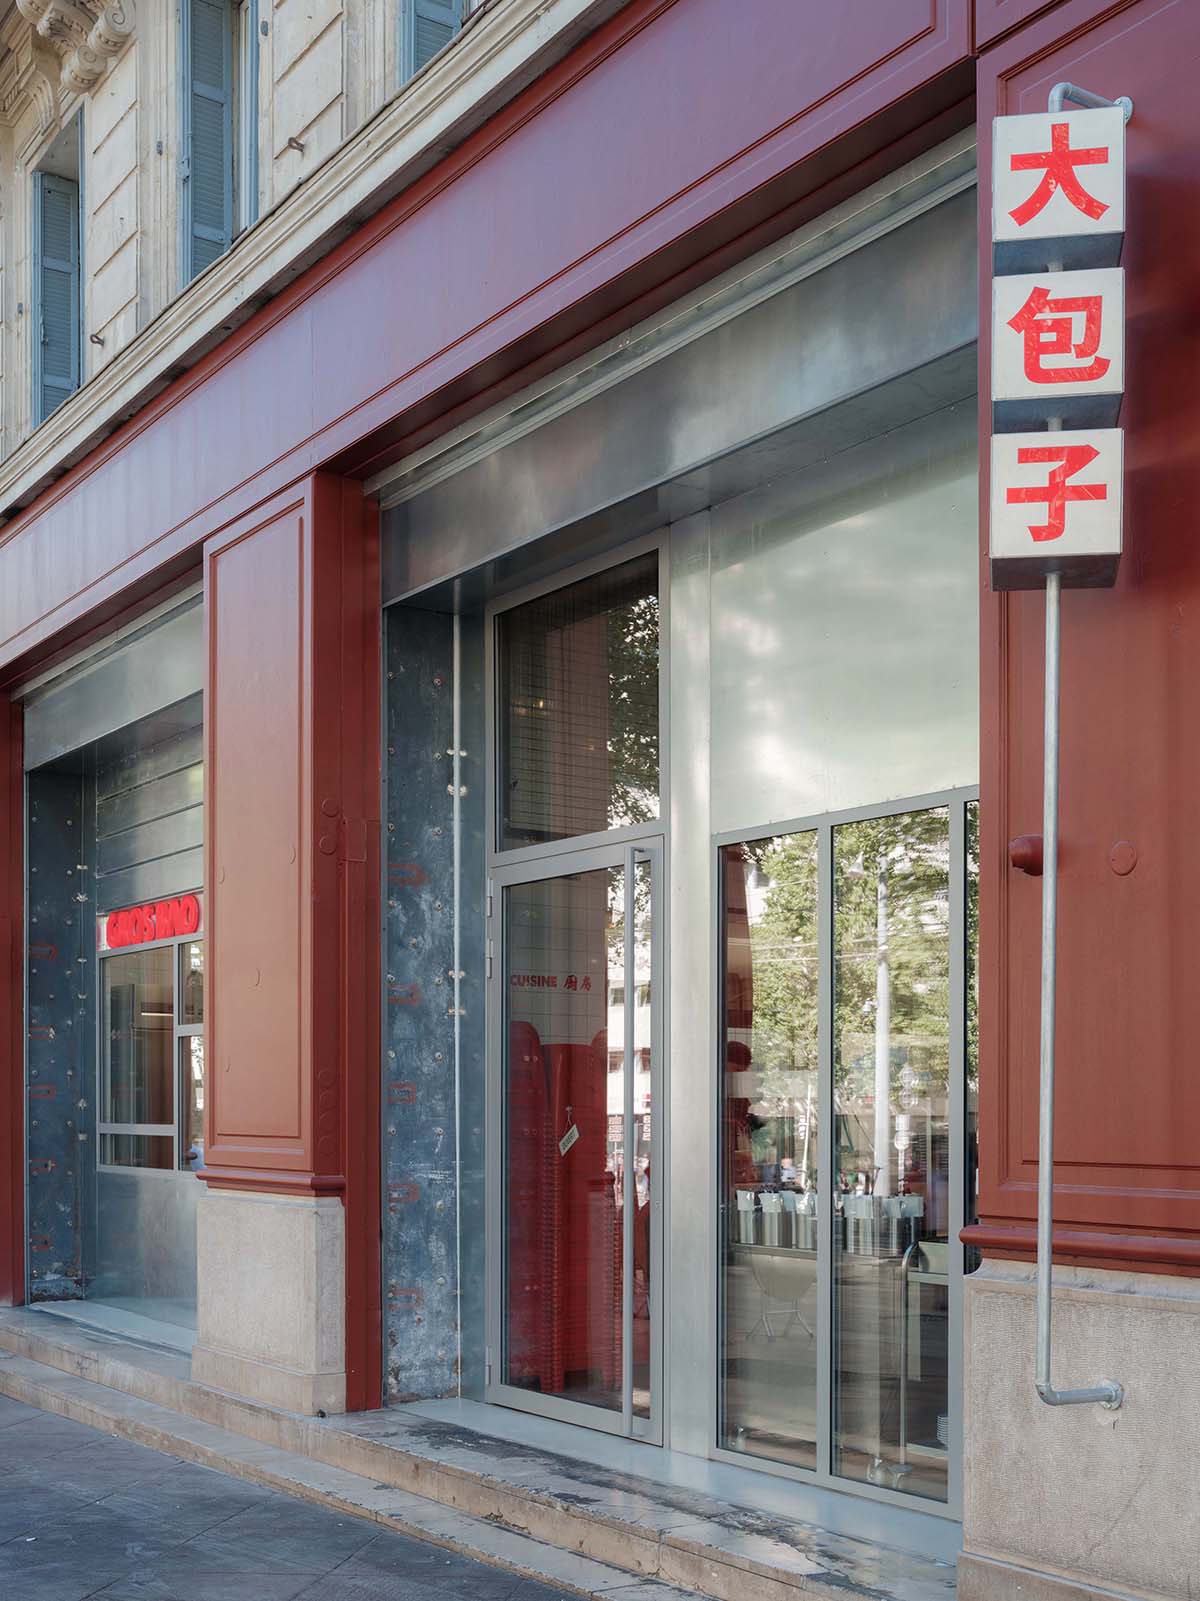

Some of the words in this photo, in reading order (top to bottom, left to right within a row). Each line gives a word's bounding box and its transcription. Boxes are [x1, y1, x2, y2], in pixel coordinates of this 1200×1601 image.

[1006, 123, 1111, 542] 大包子
[510, 974, 557, 987] CUISINE
